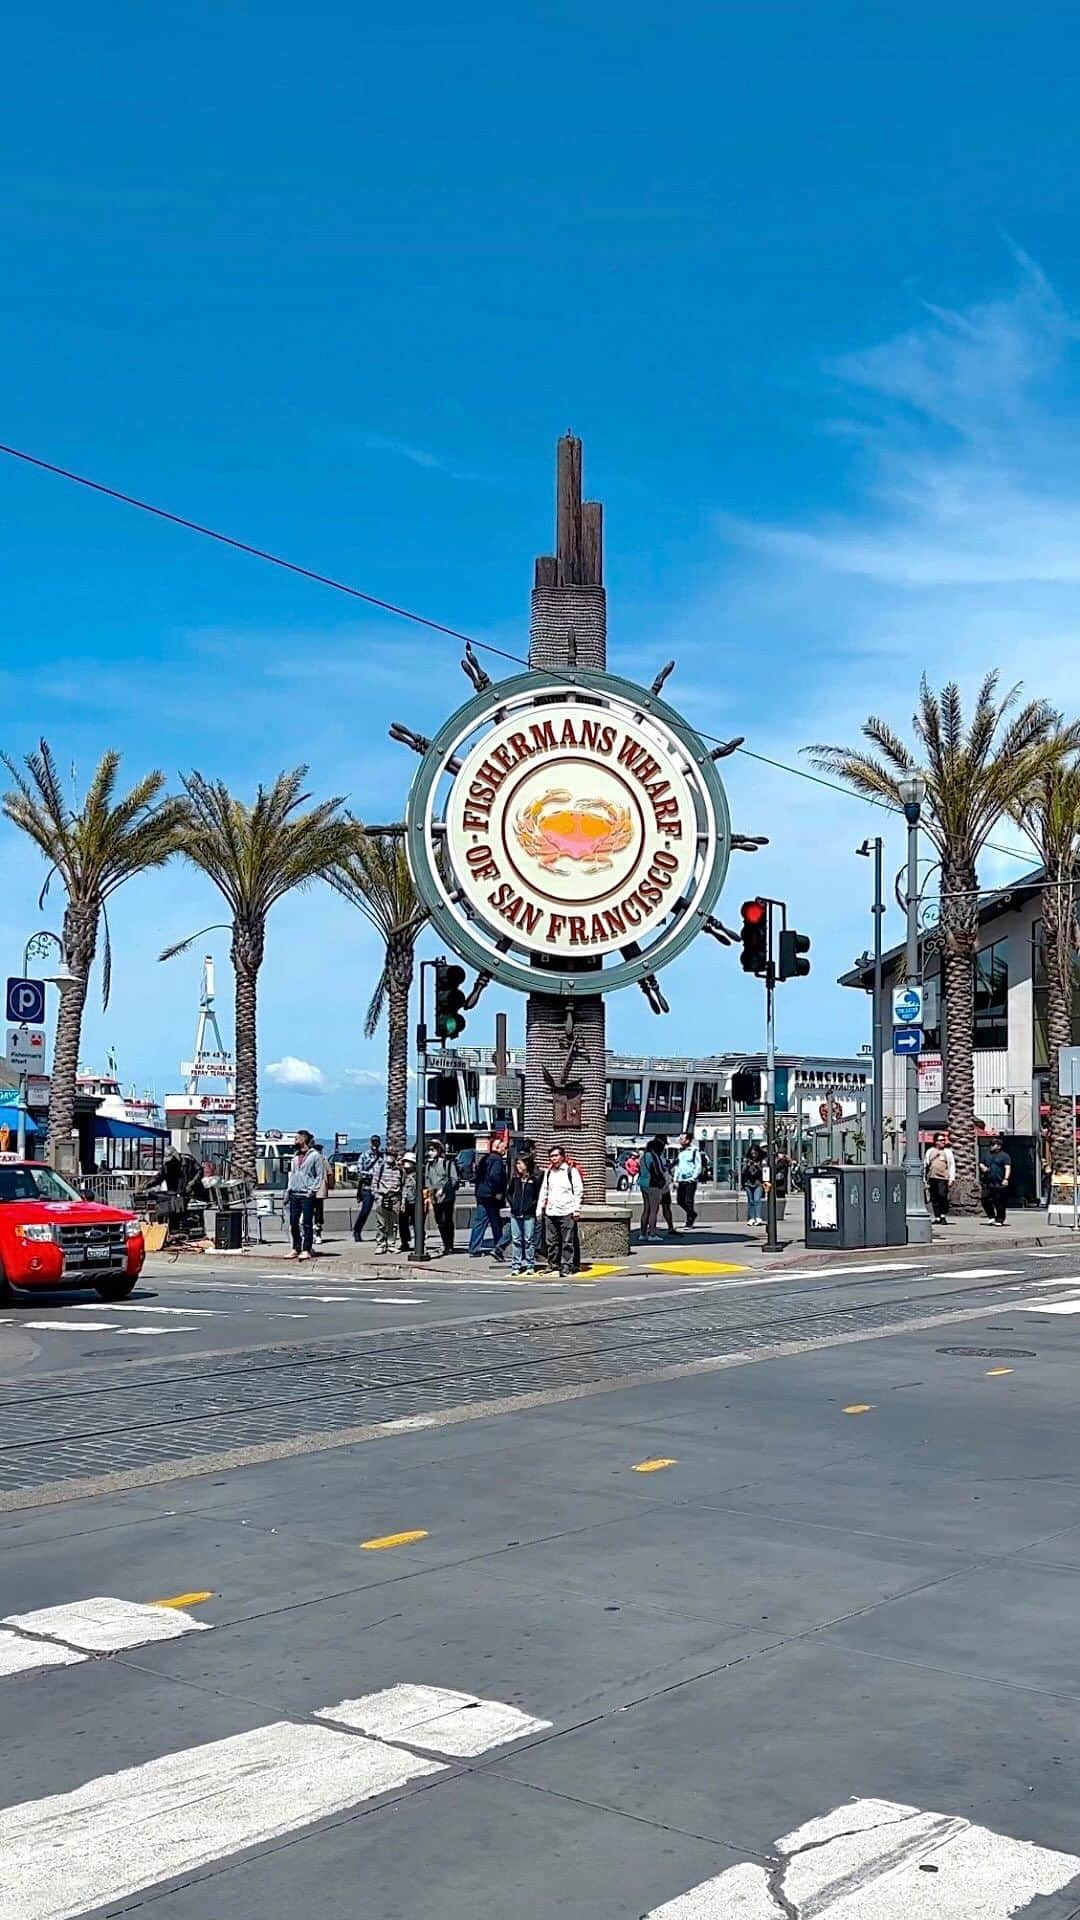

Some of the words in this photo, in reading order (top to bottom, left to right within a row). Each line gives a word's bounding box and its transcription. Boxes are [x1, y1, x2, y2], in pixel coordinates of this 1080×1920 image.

[462, 718, 617, 833] FISHERMANS
[617, 734, 683, 841] WHARF
[465, 844, 500, 882] OF
[487, 882, 544, 937] SAN
[545, 850, 679, 946] FRANCISCO
[430, 1056, 466, 1067] Jefferson
[795, 1070, 867, 1084] FRANCISCAN
